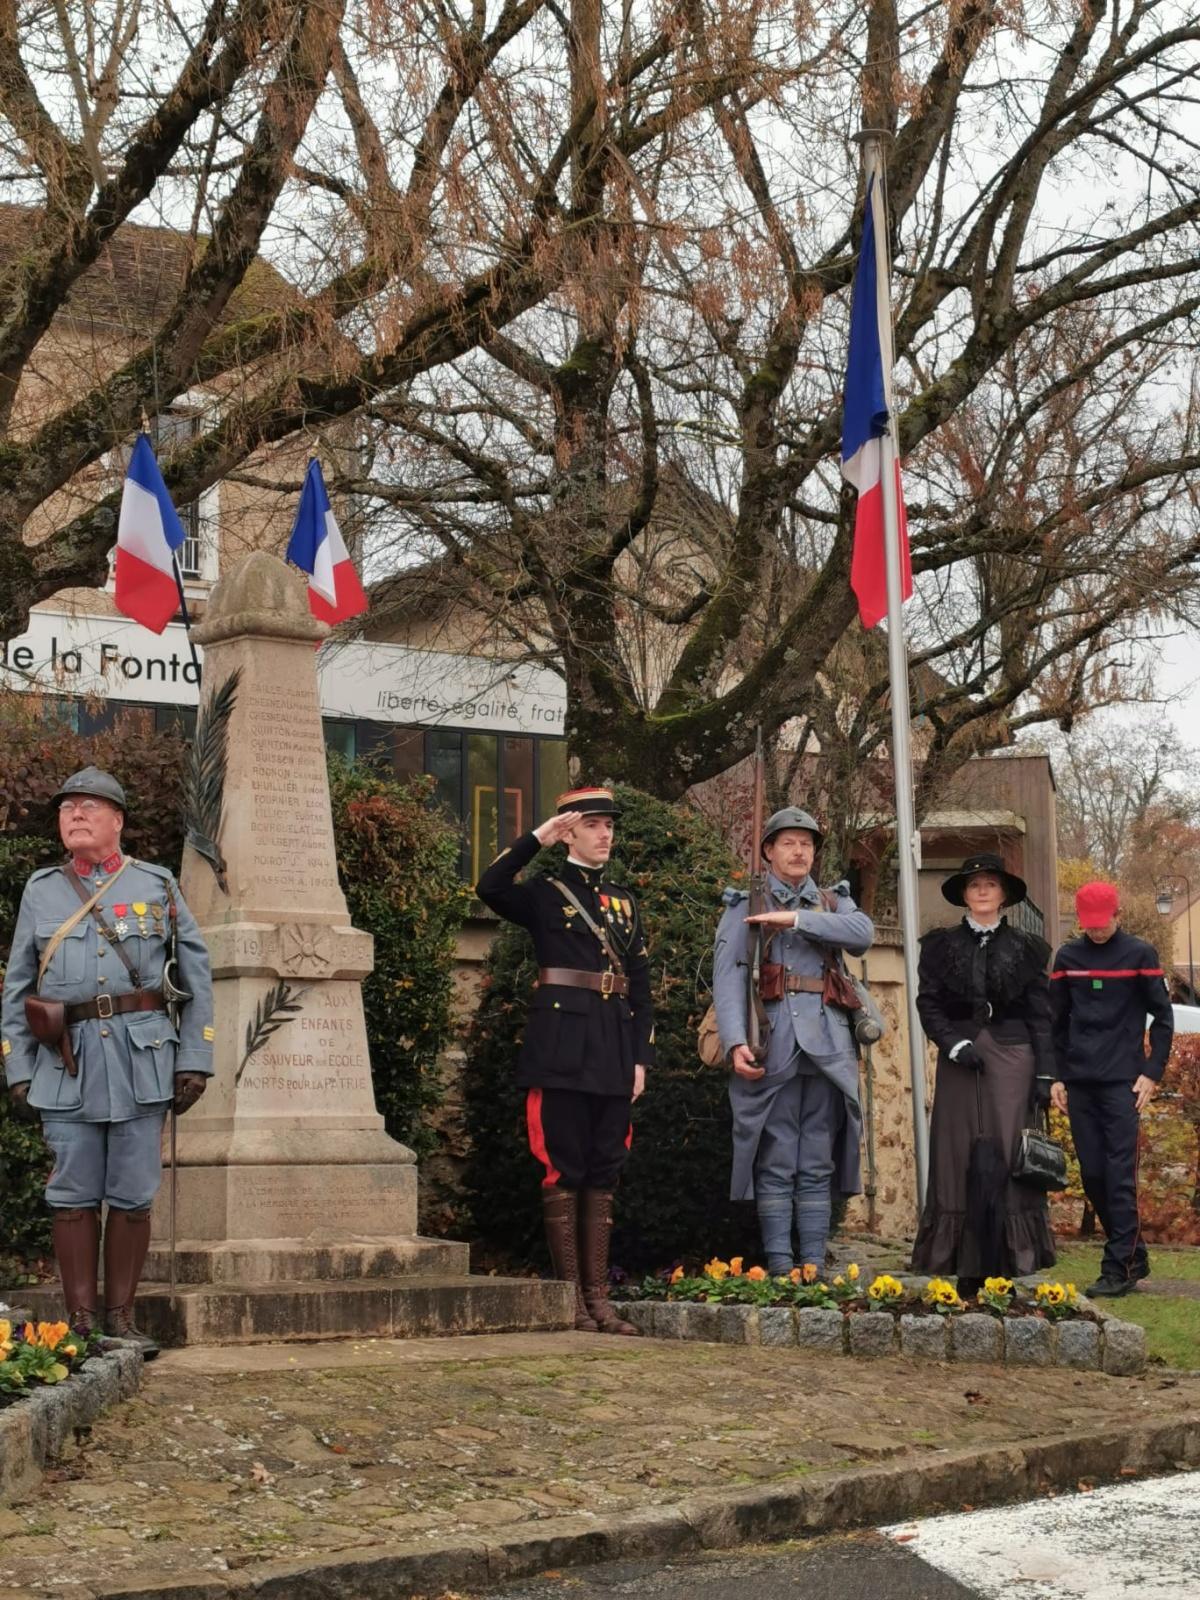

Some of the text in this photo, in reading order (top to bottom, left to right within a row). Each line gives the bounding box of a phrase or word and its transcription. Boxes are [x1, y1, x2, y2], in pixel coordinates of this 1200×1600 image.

[51, 636, 82, 674] la
[100, 642, 202, 685] Fonta
[324, 995, 349, 1009] AUX
[300, 1017, 354, 1032] ENFANTS
[318, 1038, 336, 1049] DE
[261, 1053, 314, 1068] SAUVEUR
[327, 1054, 364, 1068] ECOLE
[243, 1076, 286, 1090] MORTS
[286, 1079, 311, 1090] POUR
[311, 1079, 324, 1090] LA
